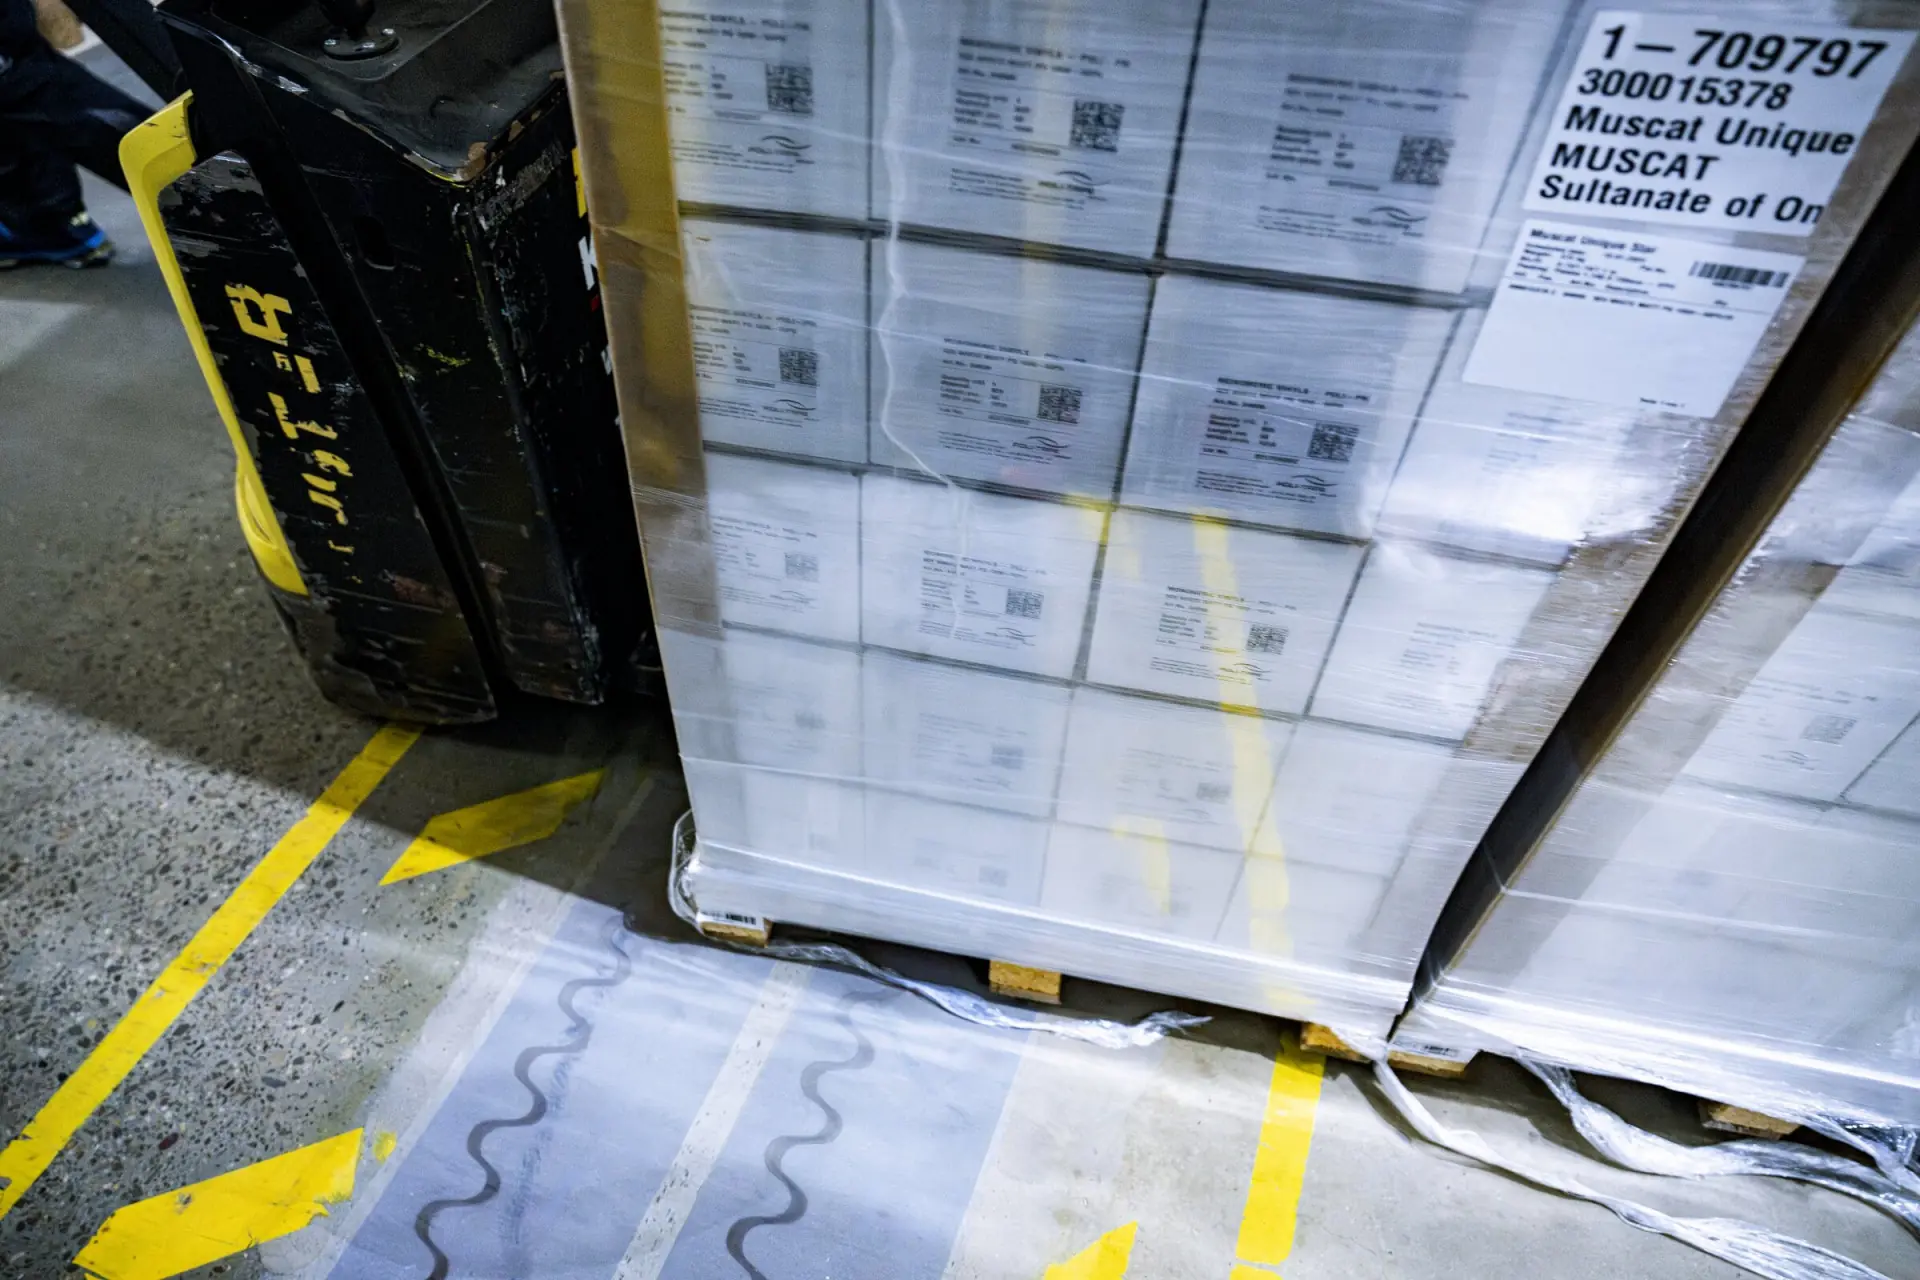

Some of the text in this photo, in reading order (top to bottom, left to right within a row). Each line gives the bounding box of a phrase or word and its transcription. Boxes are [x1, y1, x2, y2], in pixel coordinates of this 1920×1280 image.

[1603, 24, 1626, 60] 1
[1687, 29, 1889, 79] 709797
[1578, 68, 1793, 111] 300015378
[1564, 104, 1856, 157] Muscat Unique
[1551, 142, 1719, 180] MUSCAT
[1539, 174, 1711, 213] Sultanate
[1725, 194, 1766, 218] of
